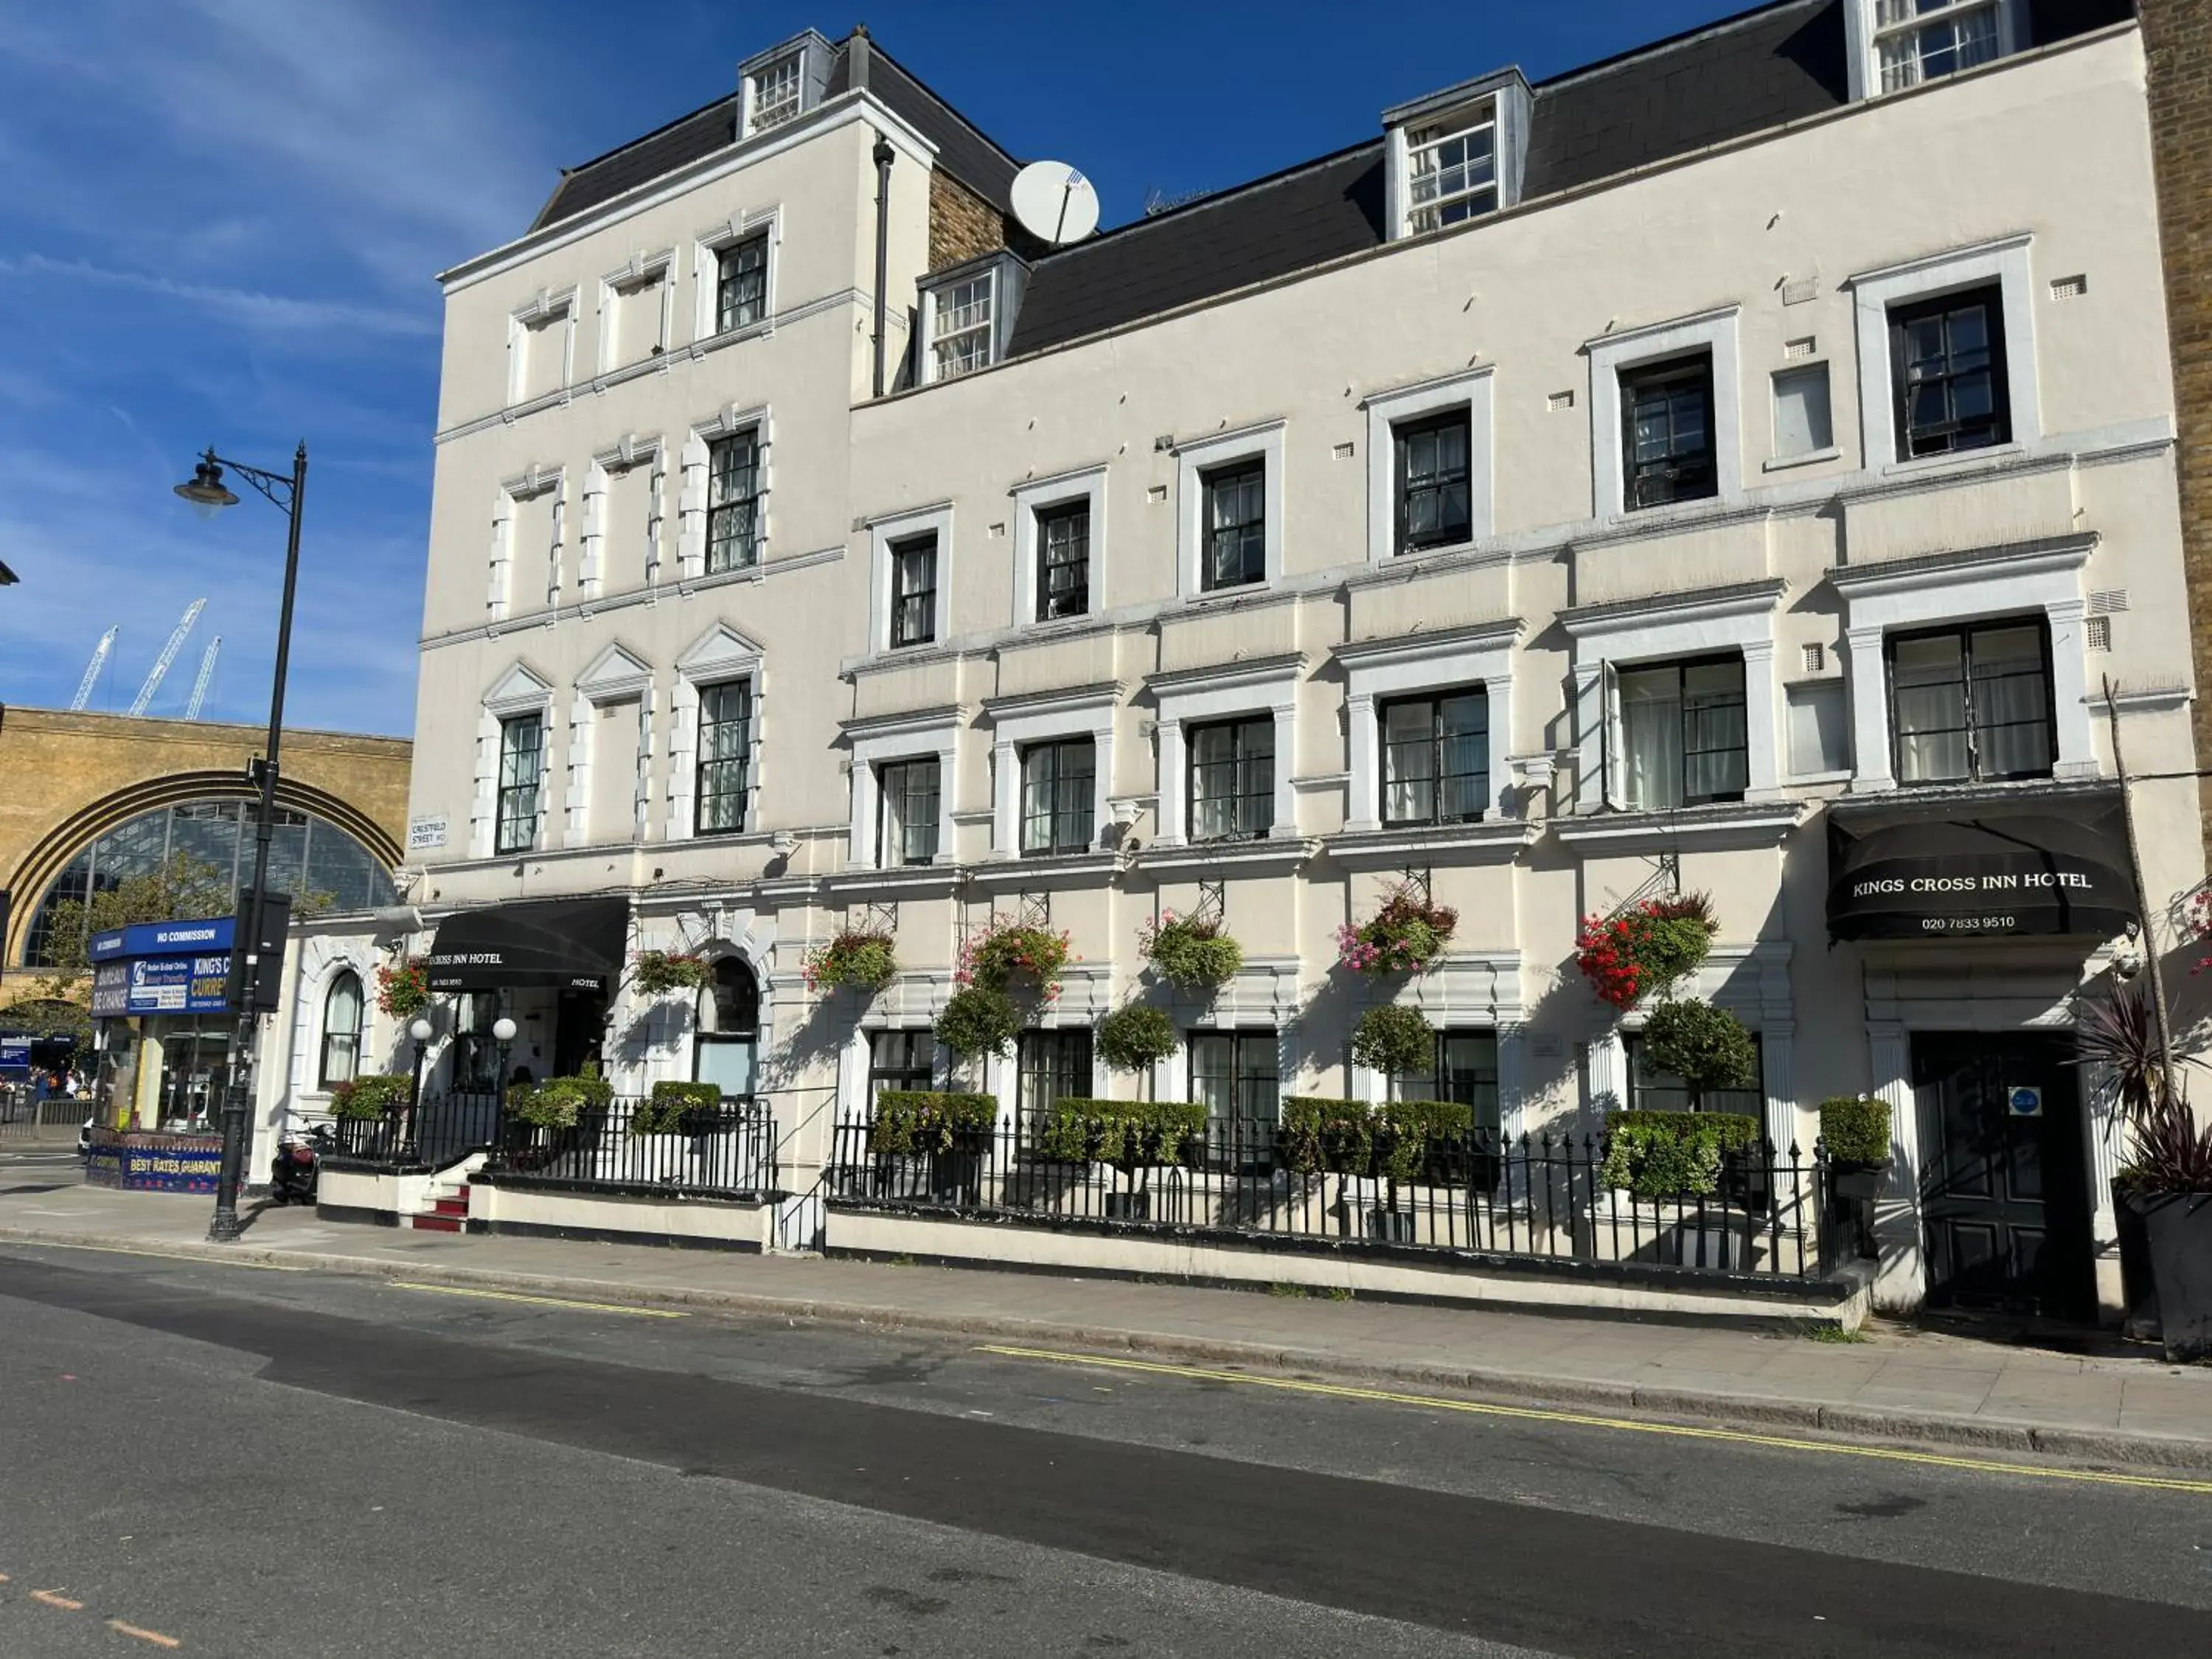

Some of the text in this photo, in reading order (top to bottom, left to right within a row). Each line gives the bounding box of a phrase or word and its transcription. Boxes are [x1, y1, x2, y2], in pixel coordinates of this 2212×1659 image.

[1853, 872, 2093, 897] KINGS CROSS INN HOTEL
[1921, 917, 2015, 930] 020 7833 9510
[157, 928, 216, 943] NO COMMISSION
[469, 953, 503, 964] HOTEL
[571, 978, 599, 989] HOTEL
[131, 1159, 152, 1172] BEST
[153, 1159, 179, 1172] RATES
